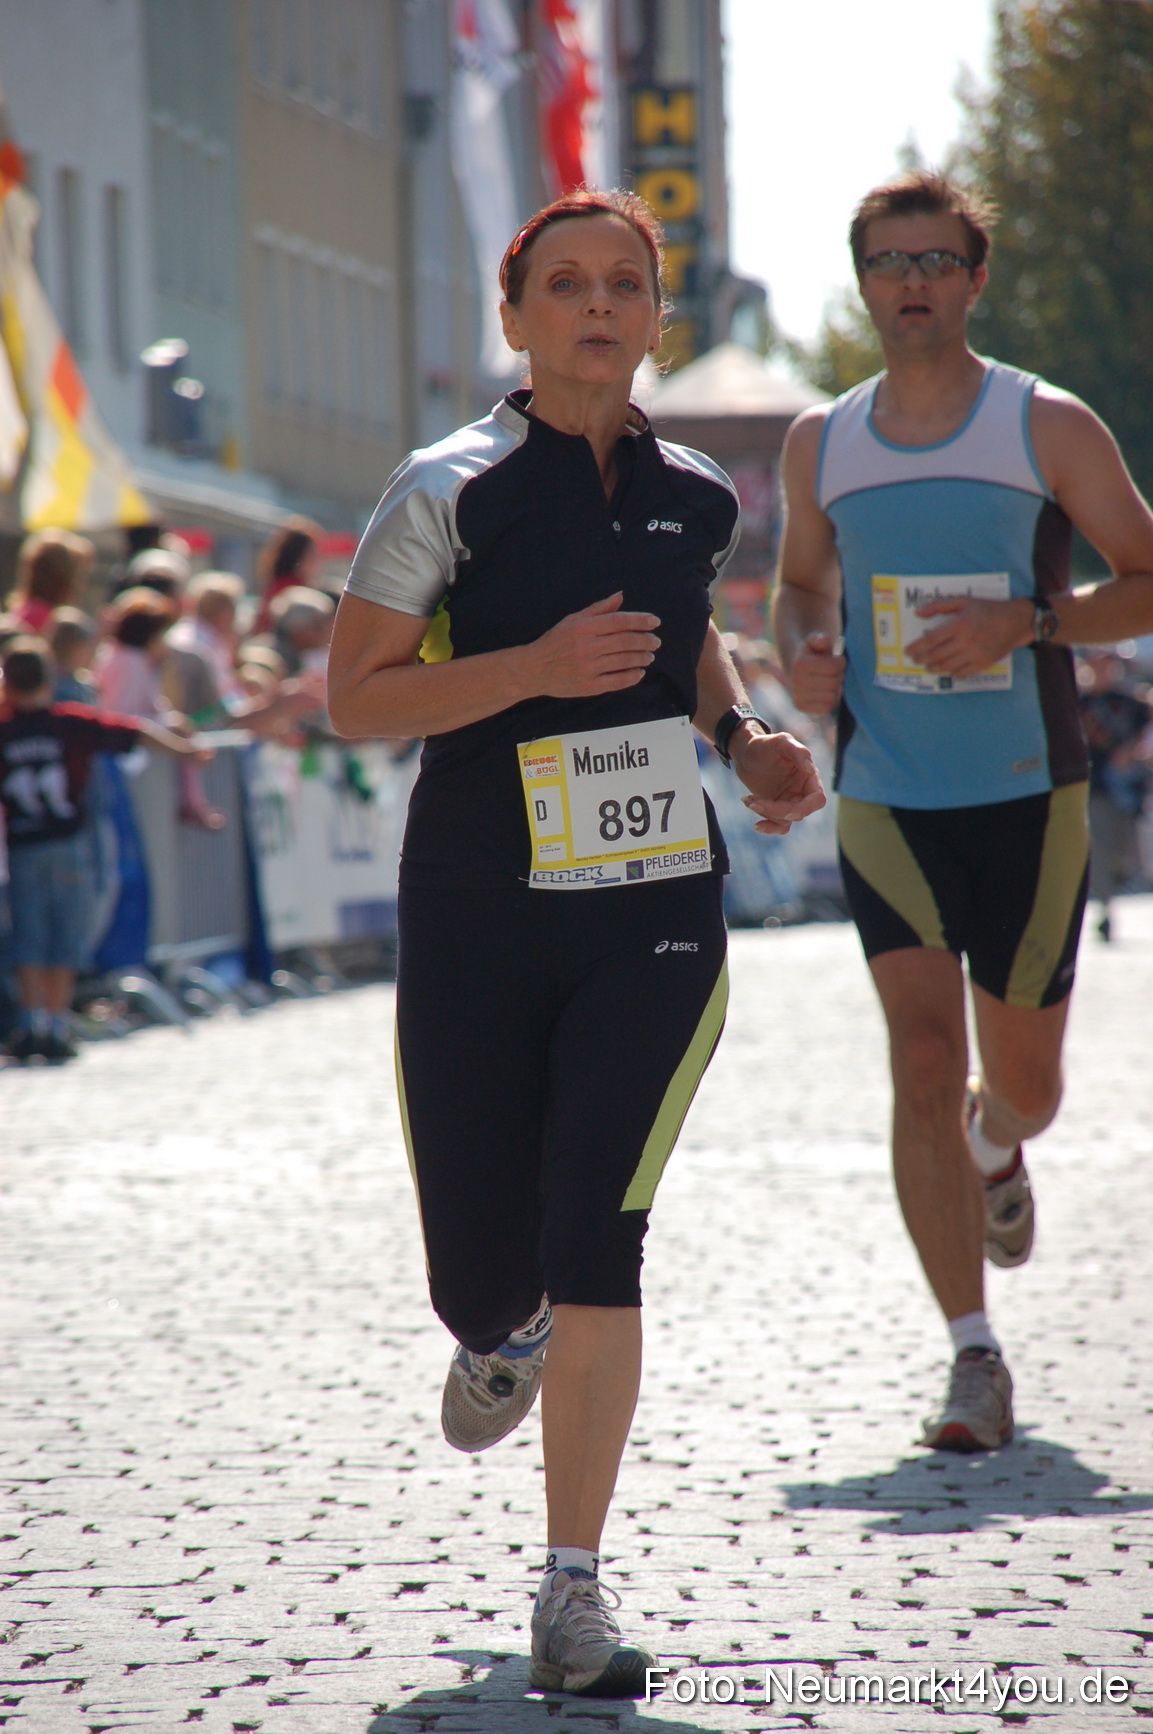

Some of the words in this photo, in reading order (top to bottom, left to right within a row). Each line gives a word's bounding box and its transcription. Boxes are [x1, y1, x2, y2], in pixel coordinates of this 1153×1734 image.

[659, 521, 683, 534] asics
[572, 741, 649, 776] Monika
[535, 800, 547, 821] D
[598, 790, 676, 842] 897
[646, 849, 708, 870] PFLEIDERER
[533, 866, 604, 883] BOCK
[671, 942, 699, 952] asics
